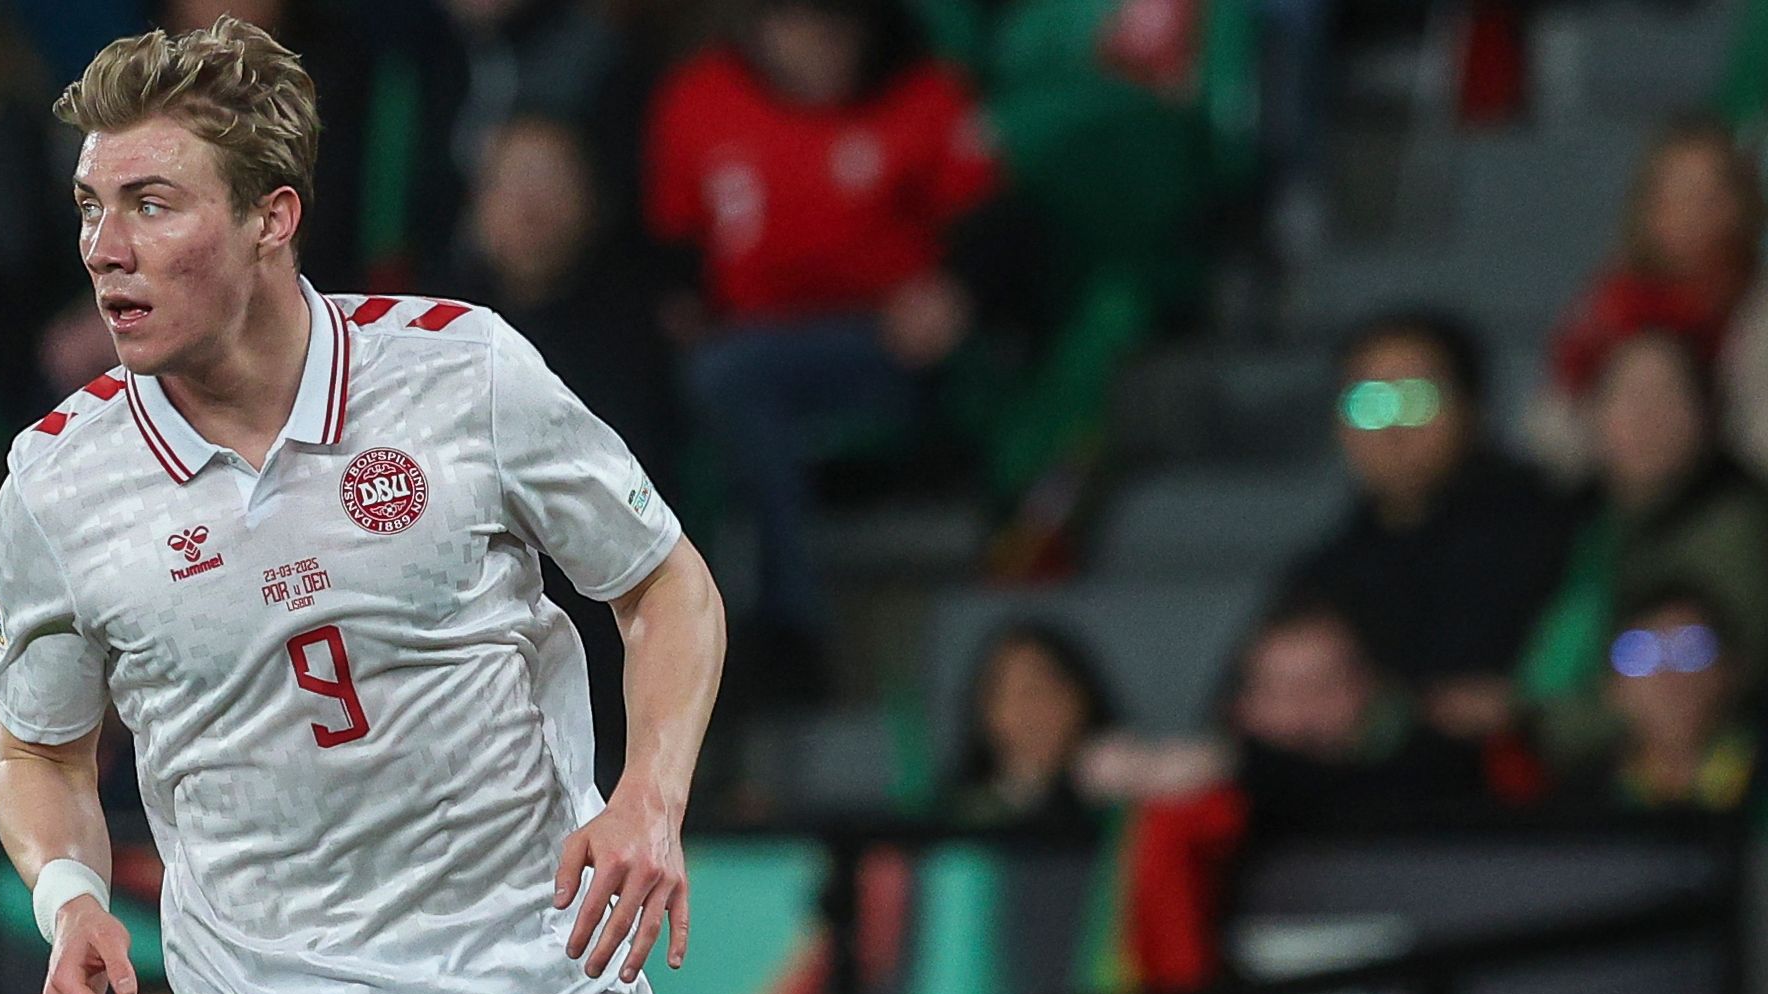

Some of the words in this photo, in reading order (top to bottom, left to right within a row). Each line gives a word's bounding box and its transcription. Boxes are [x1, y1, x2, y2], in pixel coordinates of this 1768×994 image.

[343, 480, 372, 528] DANSK
[408, 467, 426, 514] UNION
[358, 473, 411, 506] DBU
[378, 514, 412, 532] 1889
[169, 552, 225, 582] hummel
[263, 557, 320, 583] 23-03-2025
[261, 580, 291, 606] POR
[285, 623, 371, 749] 9
